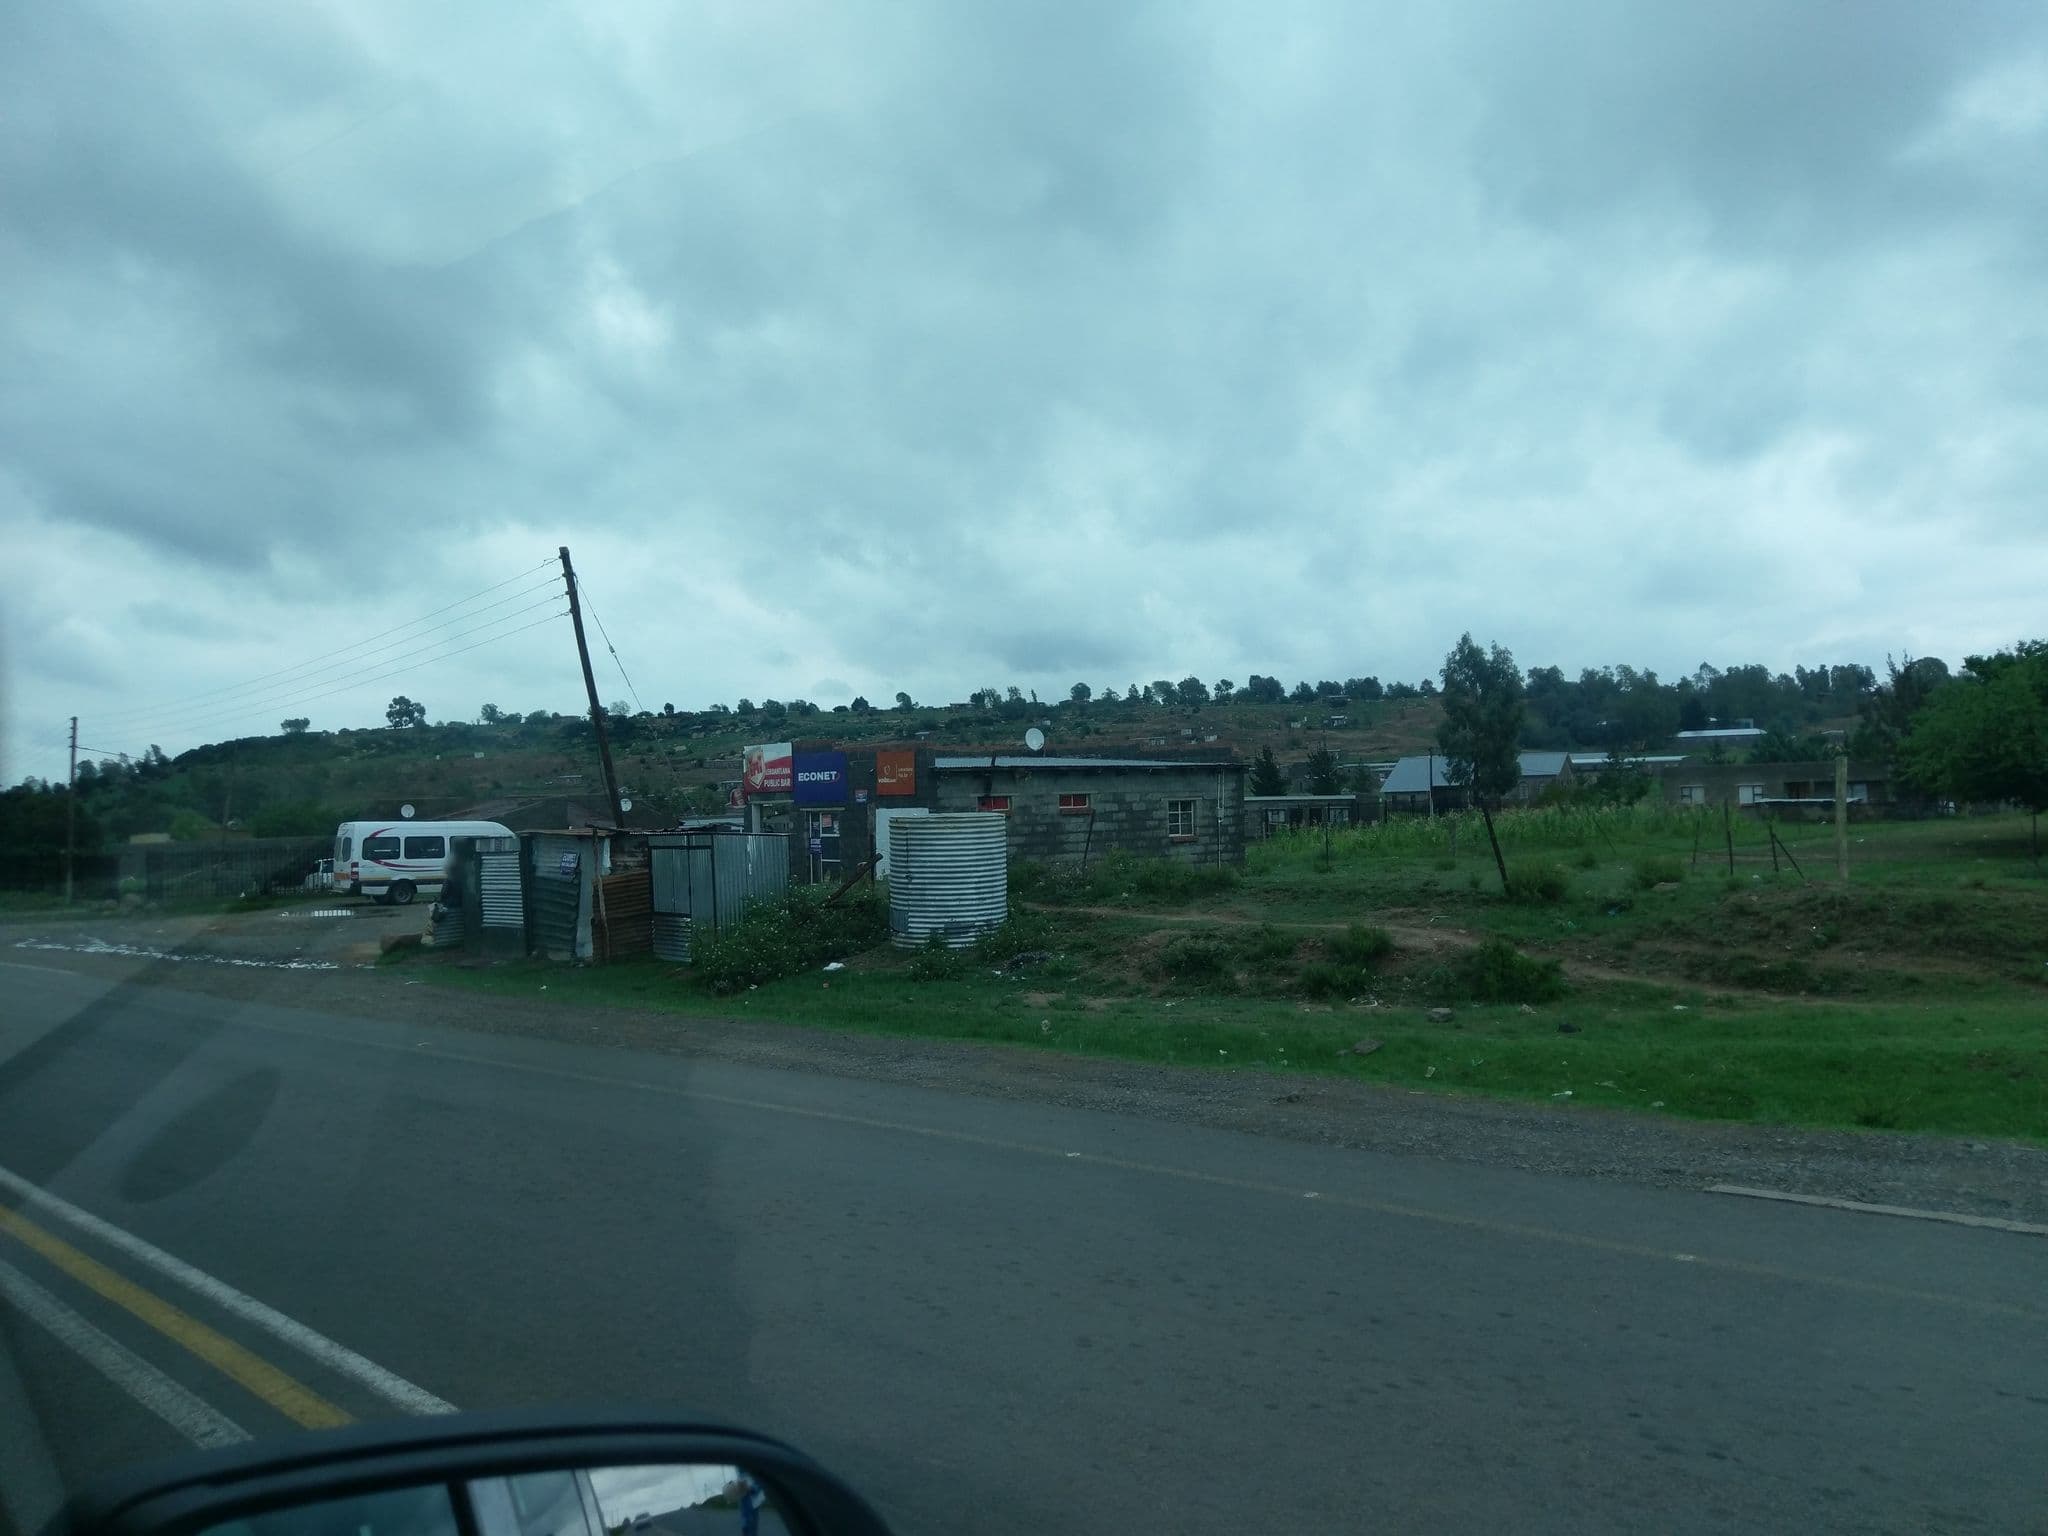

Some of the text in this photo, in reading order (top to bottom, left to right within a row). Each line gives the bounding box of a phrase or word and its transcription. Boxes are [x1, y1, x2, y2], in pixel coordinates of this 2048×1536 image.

[798, 771, 838, 782] ECONET
[764, 777, 791, 788] PUBLIC BAR
